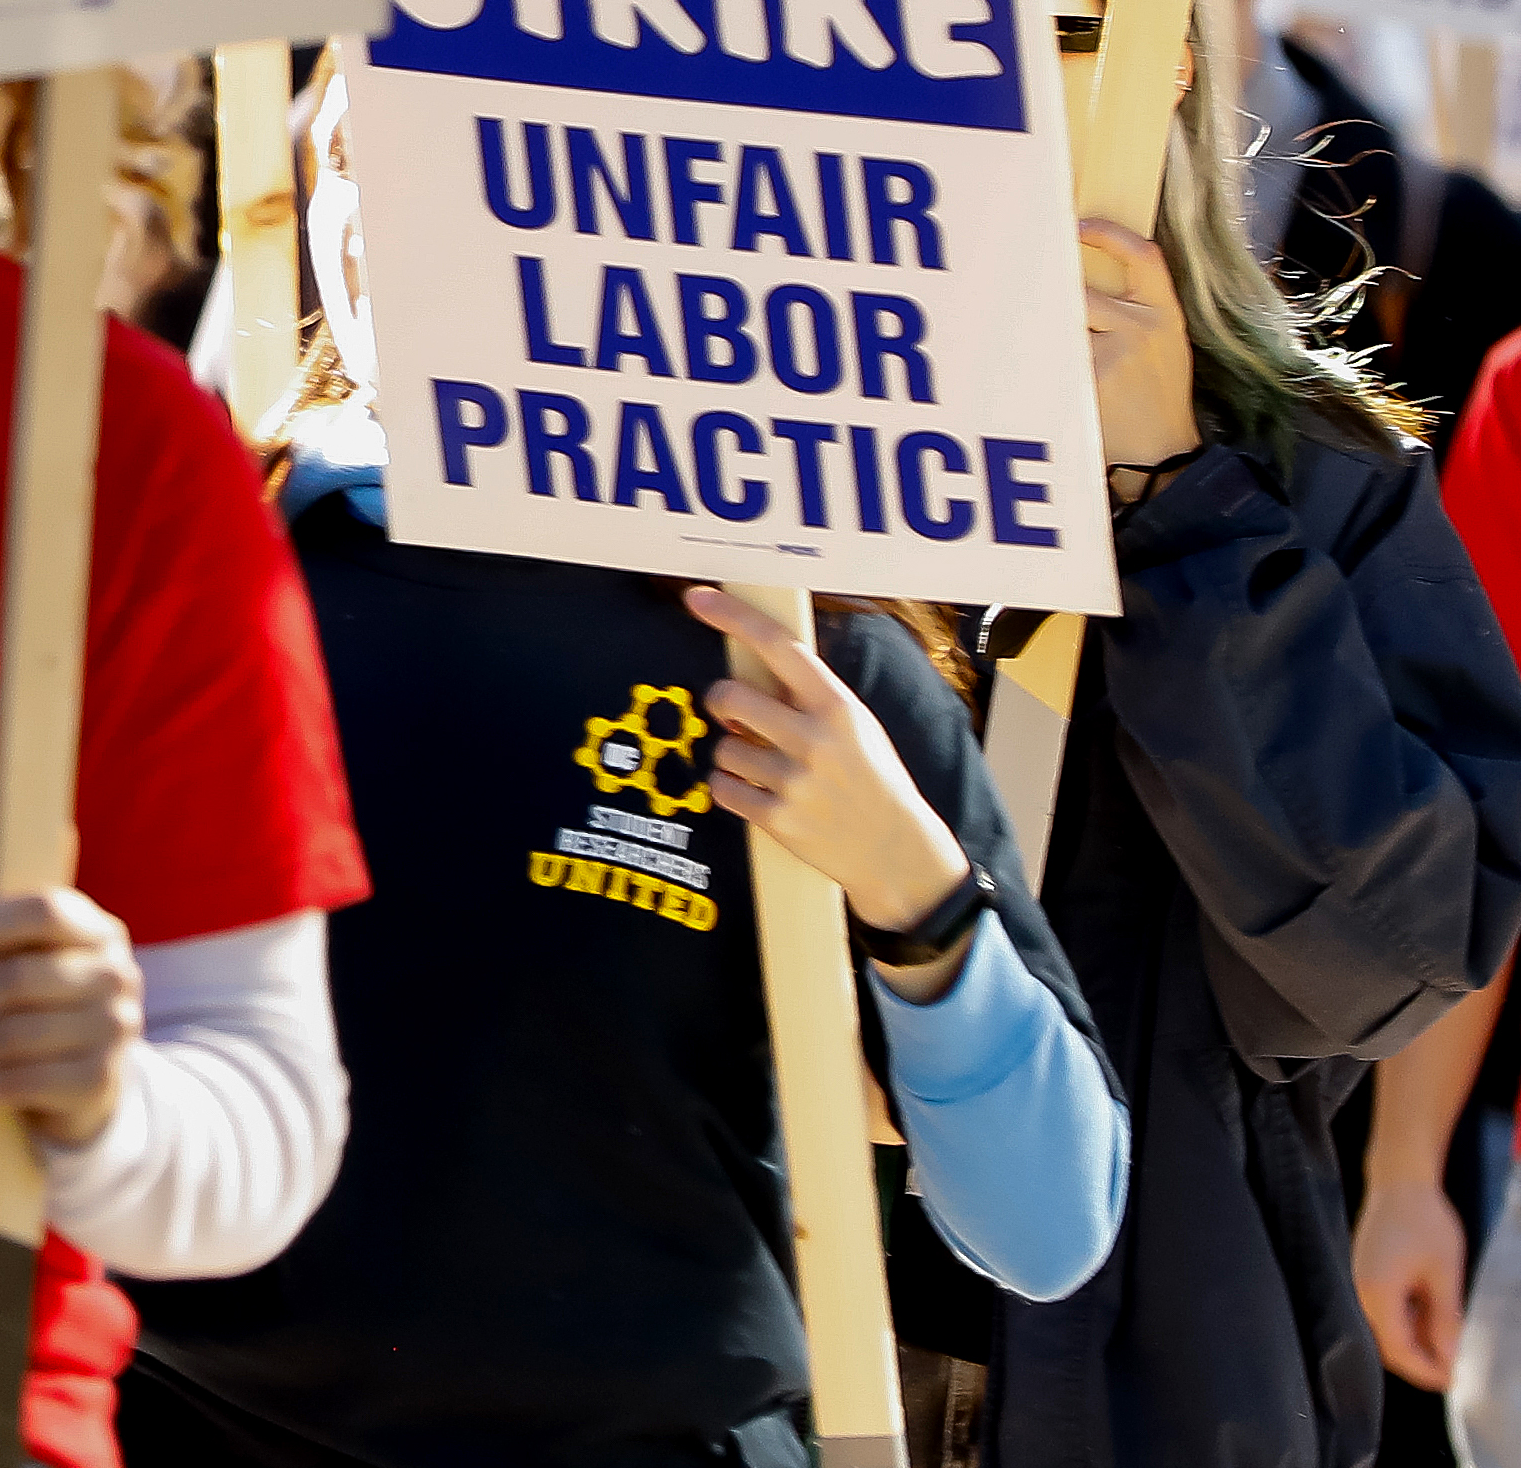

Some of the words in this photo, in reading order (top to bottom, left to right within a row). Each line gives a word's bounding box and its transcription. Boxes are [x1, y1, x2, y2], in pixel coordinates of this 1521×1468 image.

[474, 116, 948, 271] UNFAIR
[514, 254, 940, 406] LABOR
[431, 378, 1064, 550] PRACTICE
[526, 849, 720, 933] UNITED
